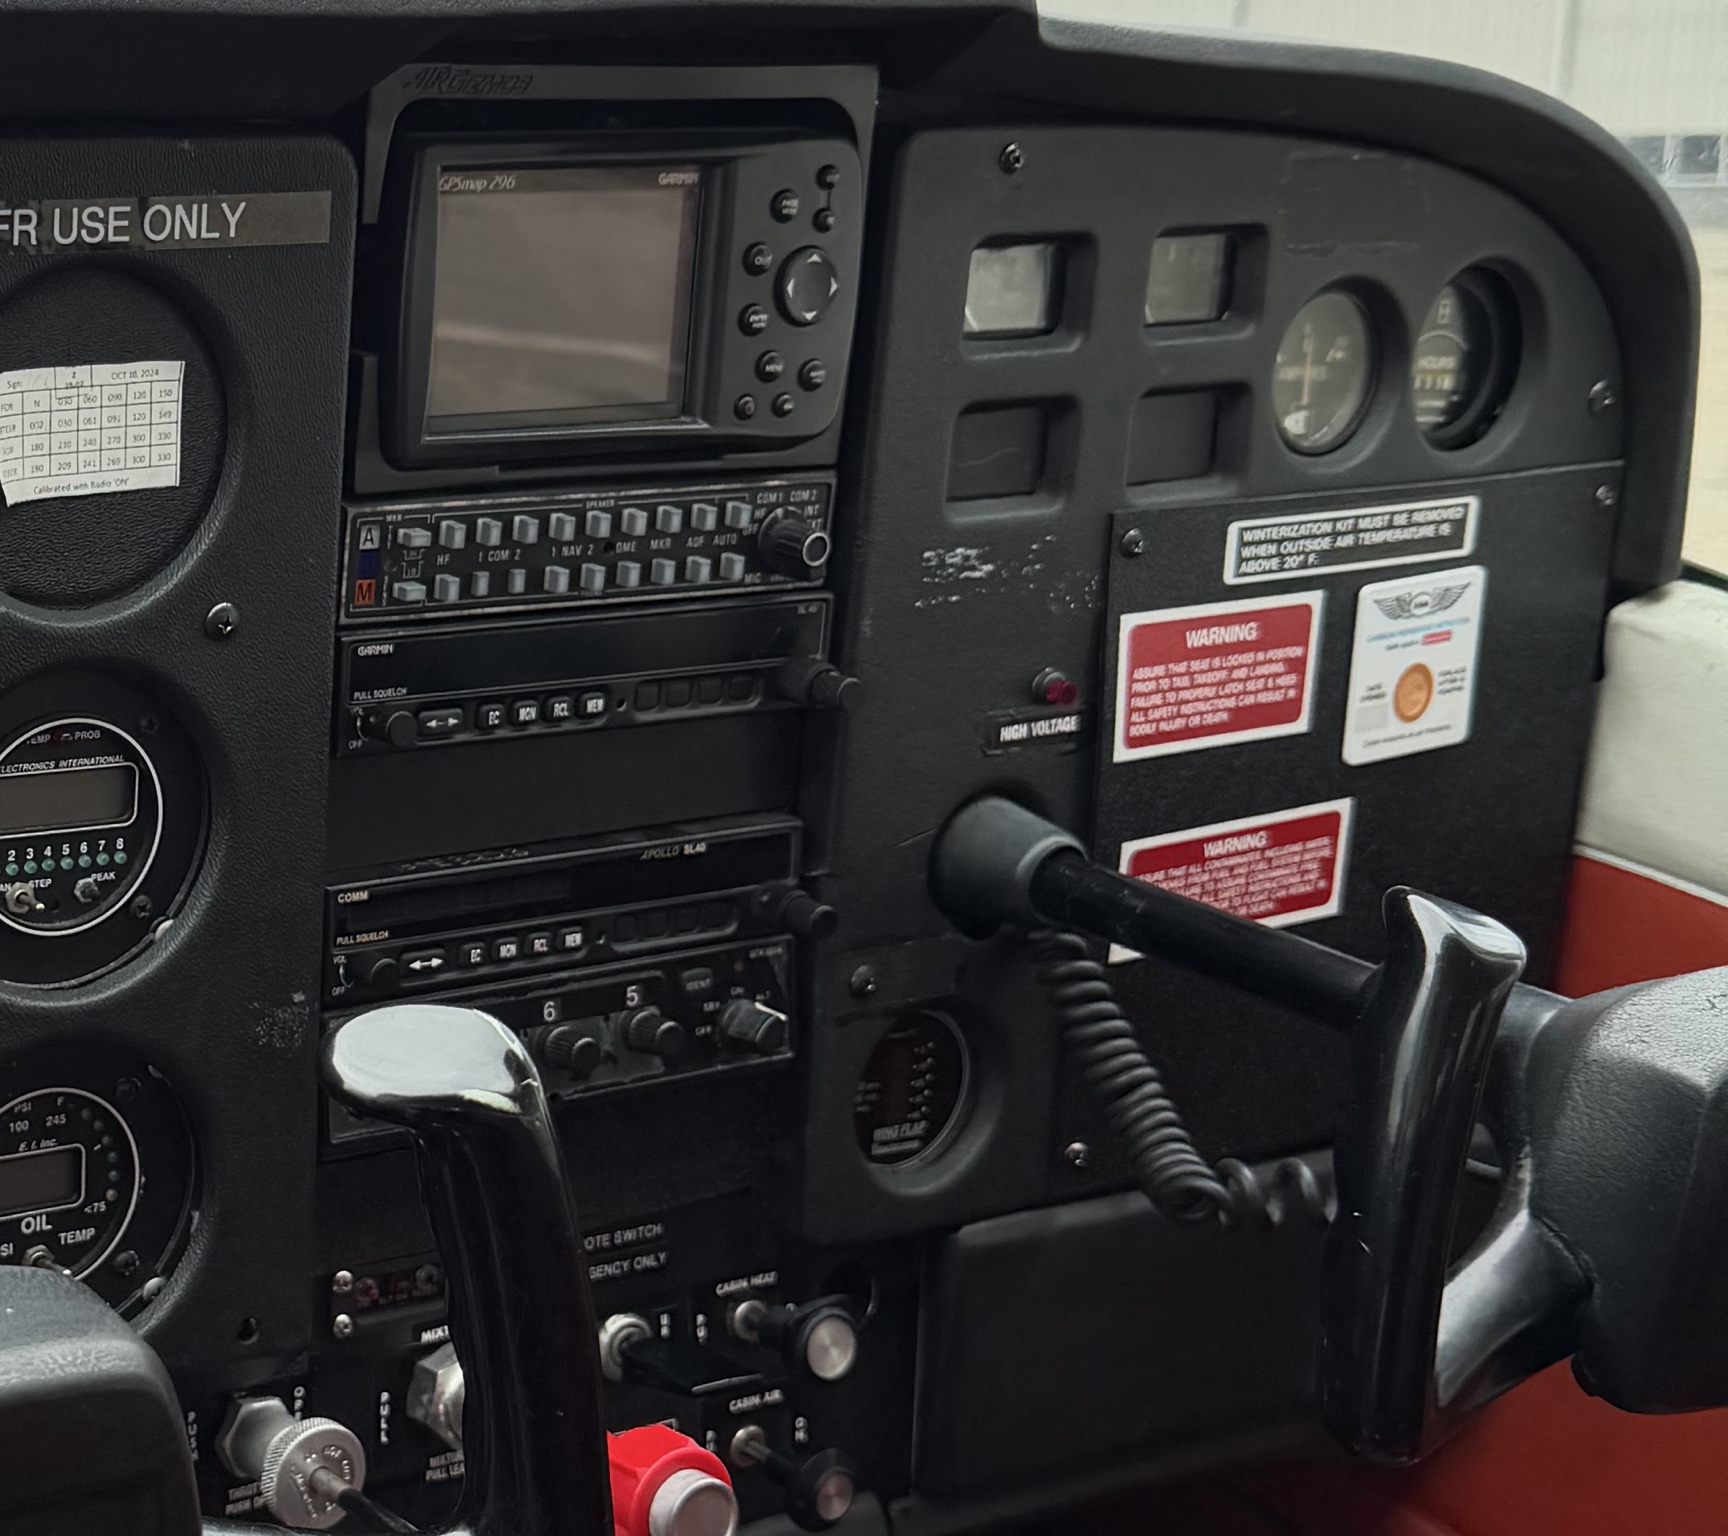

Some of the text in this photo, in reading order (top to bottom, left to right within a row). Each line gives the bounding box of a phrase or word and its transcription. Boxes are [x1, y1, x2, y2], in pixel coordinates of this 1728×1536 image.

[658, 173, 699, 186] GARMIN
[53, 206, 132, 244] USE
[143, 201, 246, 241] ONLY
[111, 371, 127, 380] OCT
[141, 369, 159, 377] 2024
[34, 484, 71, 494] Calibrated
[73, 483, 88, 491] with
[1243, 521, 1333, 542] WINTERIZATION
[1358, 515, 1390, 529] MUST
[616, 541, 636, 553] DME
[650, 538, 672, 549] MKR
[1241, 543, 1277, 559] WHEN
[1280, 535, 1334, 553] OUTSIDE
[1358, 525, 1436, 545] TEMPERATURE
[488, 550, 510, 562] COM
[514, 549, 520, 560] 2
[1186, 621, 1260, 649] WARNING
[357, 644, 393, 657] GARMIN
[353, 686, 407, 701] PULL SQUELCH
[999, 714, 1080, 742] HIGH VOLTAGE
[1203, 831, 1269, 858] WARNING
[91, 871, 116, 882] PEAK
[337, 891, 369, 904] COMM
[626, 986, 639, 1006] 5
[543, 1001, 556, 1020] 6
[22, 1215, 52, 1234] OIL
[614, 1223, 662, 1243] SWITCH
[58, 1228, 96, 1244] TEMP
[633, 1251, 666, 1269] ONLY
[716, 1272, 778, 1296] CABIN HEAT
